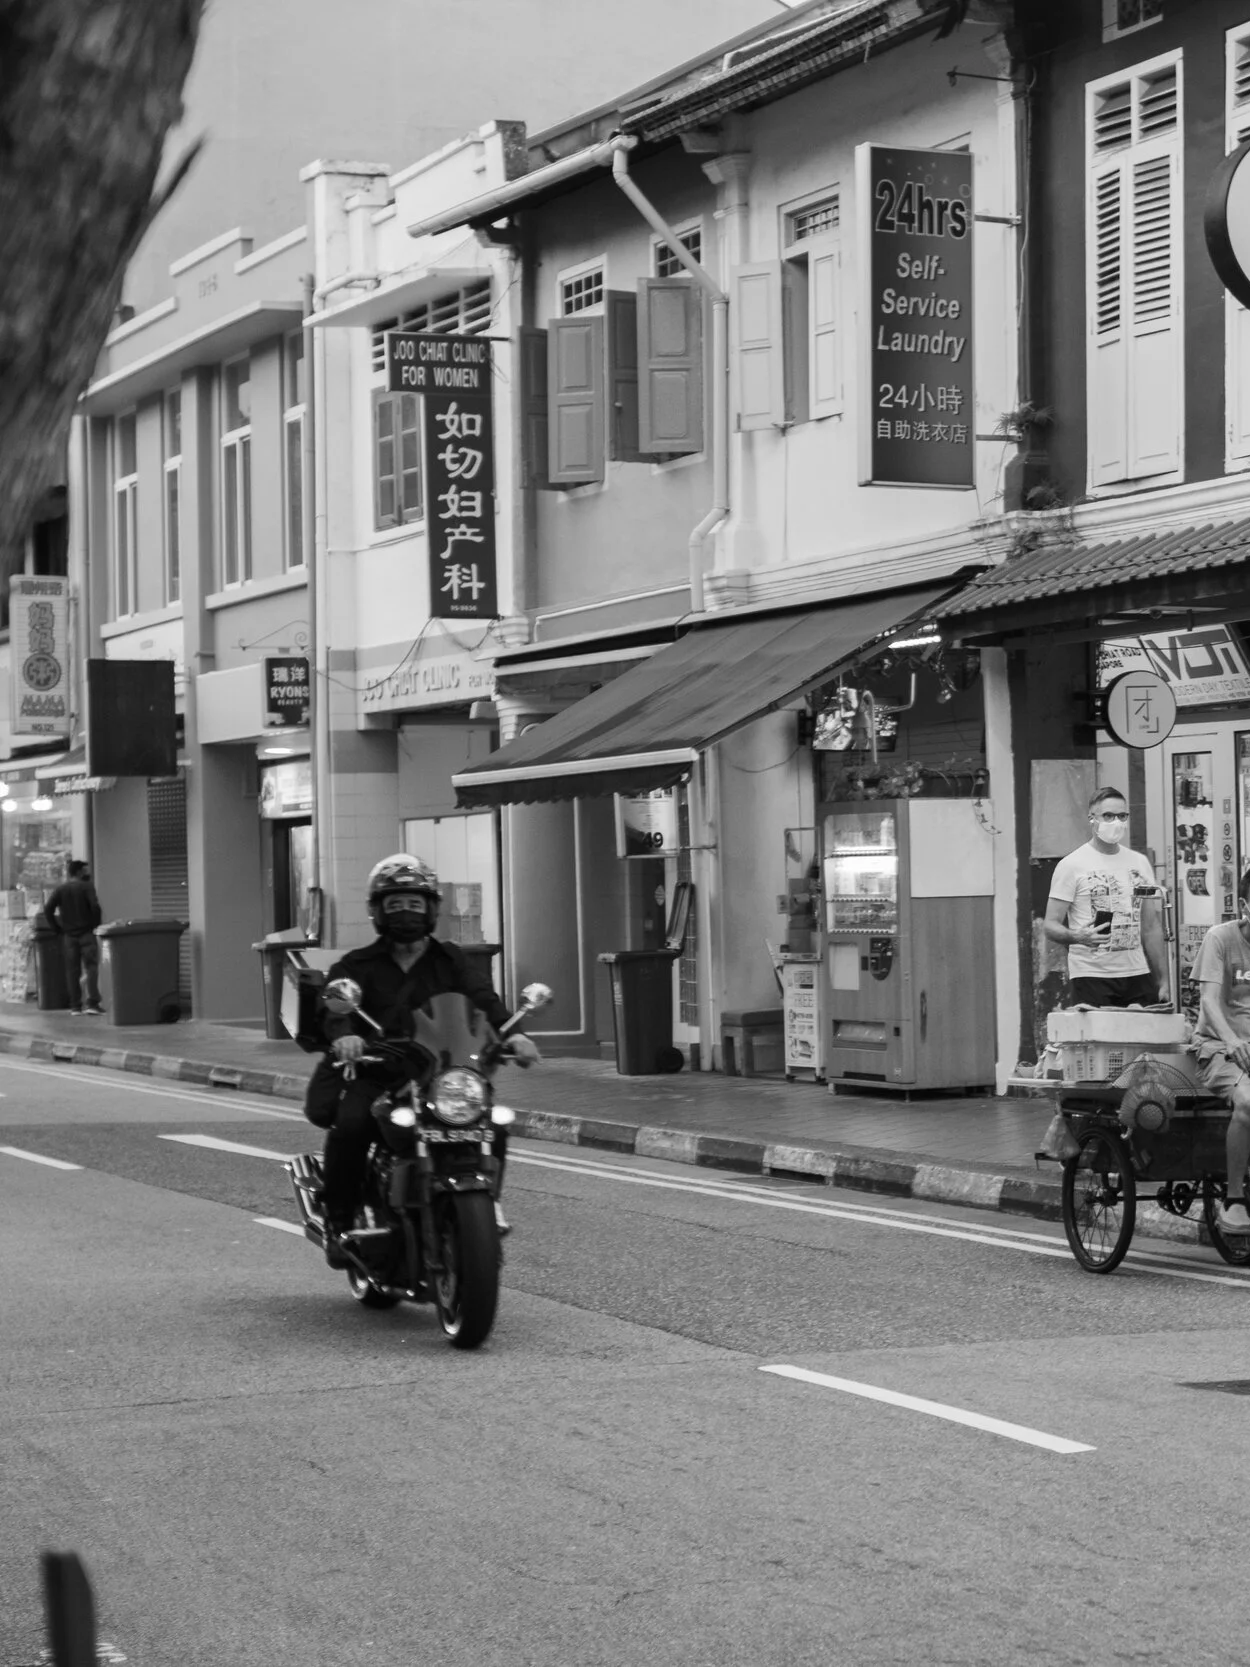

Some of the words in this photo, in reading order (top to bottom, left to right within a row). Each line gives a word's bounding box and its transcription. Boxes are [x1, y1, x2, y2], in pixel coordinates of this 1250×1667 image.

[875, 179, 967, 239] 24hrs
[896, 251, 945, 280] Self-
[881, 288, 960, 319] Service
[393, 340, 415, 360] JOO
[419, 341, 448, 361] CHIAT
[452, 343, 485, 363] CLINIC
[877, 325, 965, 362] Laundry
[401, 366, 426, 386] FOR
[433, 367, 478, 388] WOMEN
[878, 383, 963, 415] 24小時
[877, 418, 968, 444] 自助洗衣店
[435, 401, 485, 600] 如切妇产科
[270, 685, 309, 699] RYONS
